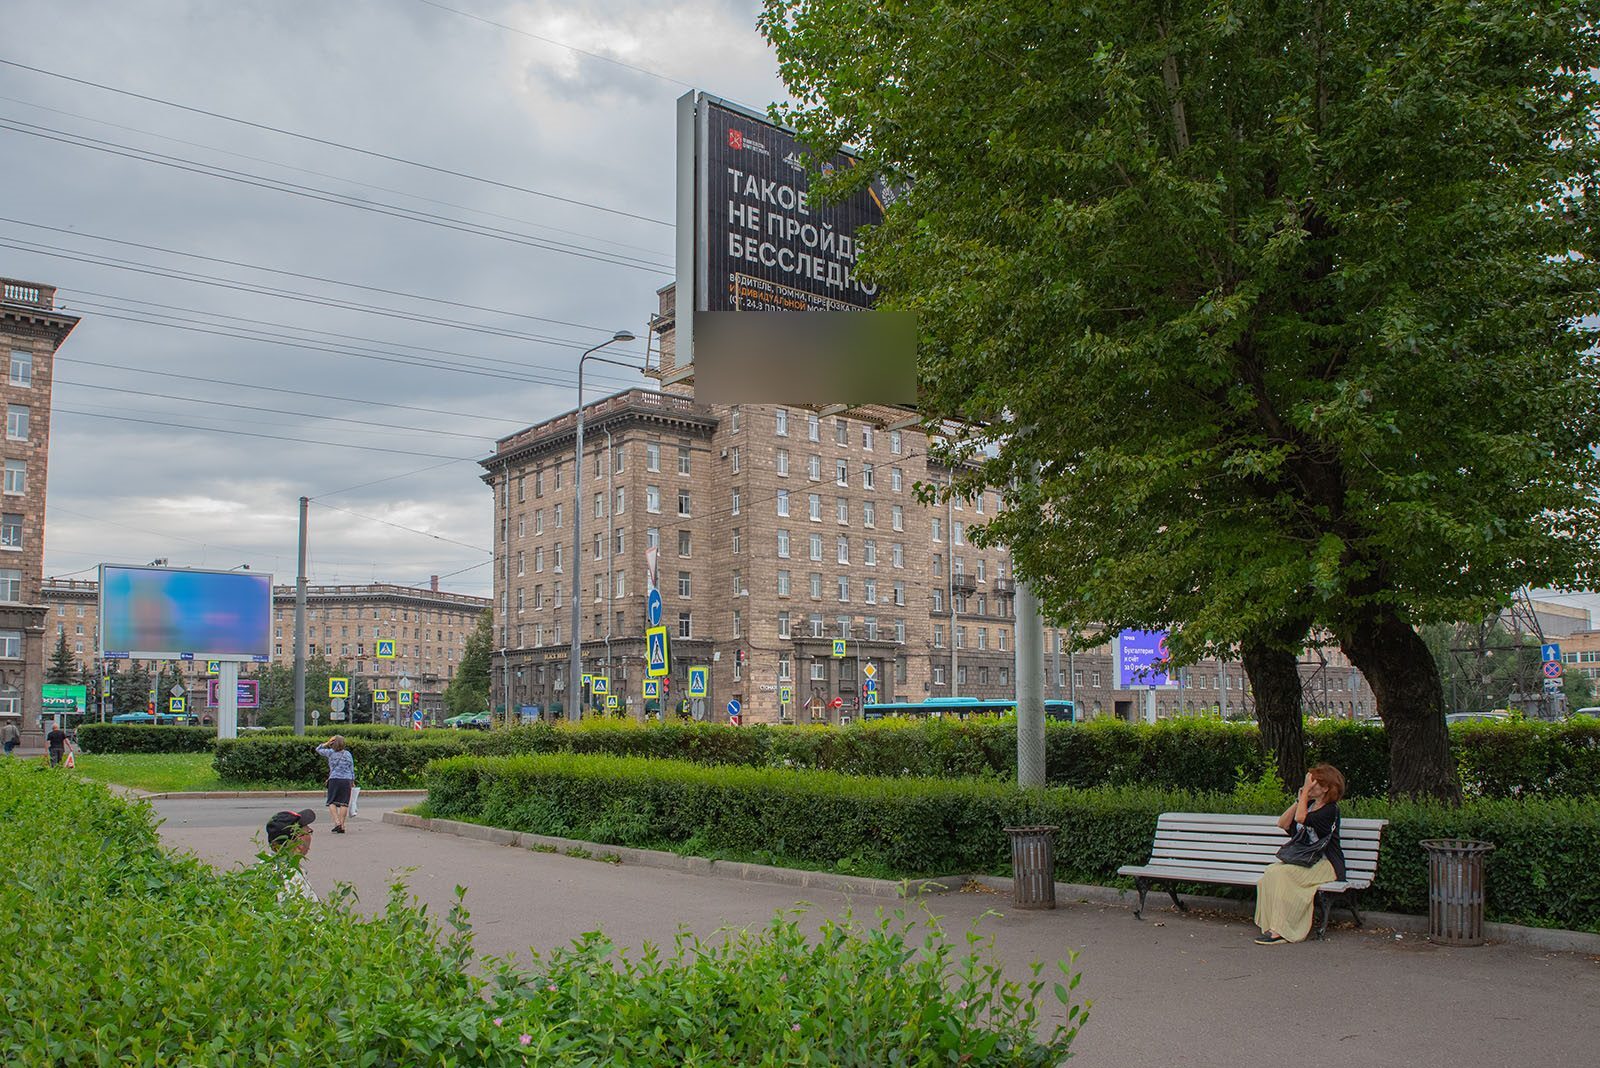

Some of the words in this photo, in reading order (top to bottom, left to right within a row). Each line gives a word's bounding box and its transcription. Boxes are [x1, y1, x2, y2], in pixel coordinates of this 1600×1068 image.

[728, 168, 809, 216] ТАКОЕ
[729, 200, 760, 231] НЕ
[767, 212, 865, 264] ПРОЙДЕ
[729, 232, 878, 295] БЕССЛЕДНО
